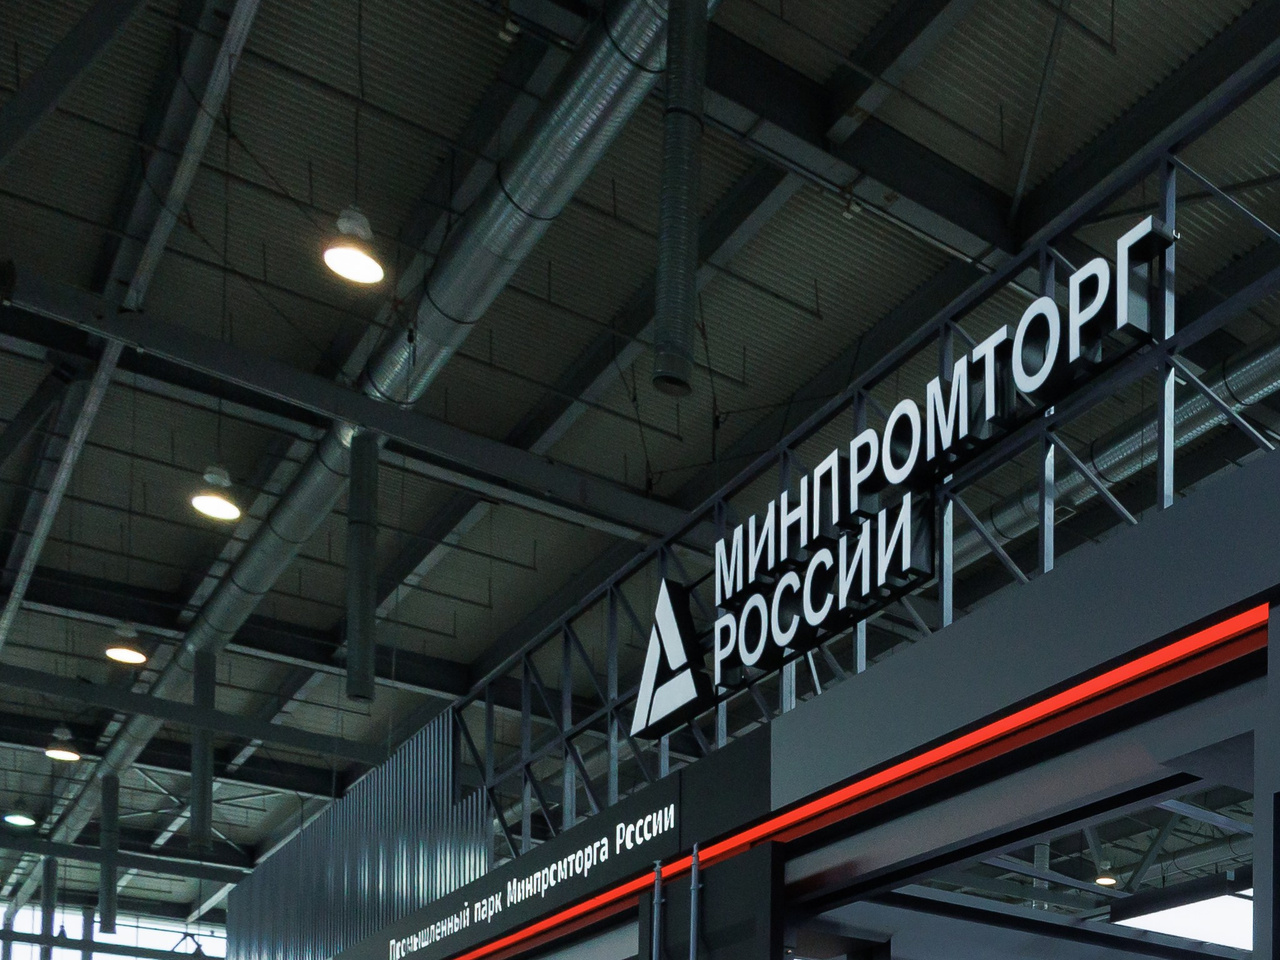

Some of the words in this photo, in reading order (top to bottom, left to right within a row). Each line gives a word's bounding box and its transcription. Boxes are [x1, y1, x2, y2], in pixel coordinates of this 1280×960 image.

[715, 215, 1165, 606] МИНПРОМТОРГ
[715, 492, 912, 685] РОССИИ
[474, 892, 502, 923] парк
[616, 804, 675, 855] России
